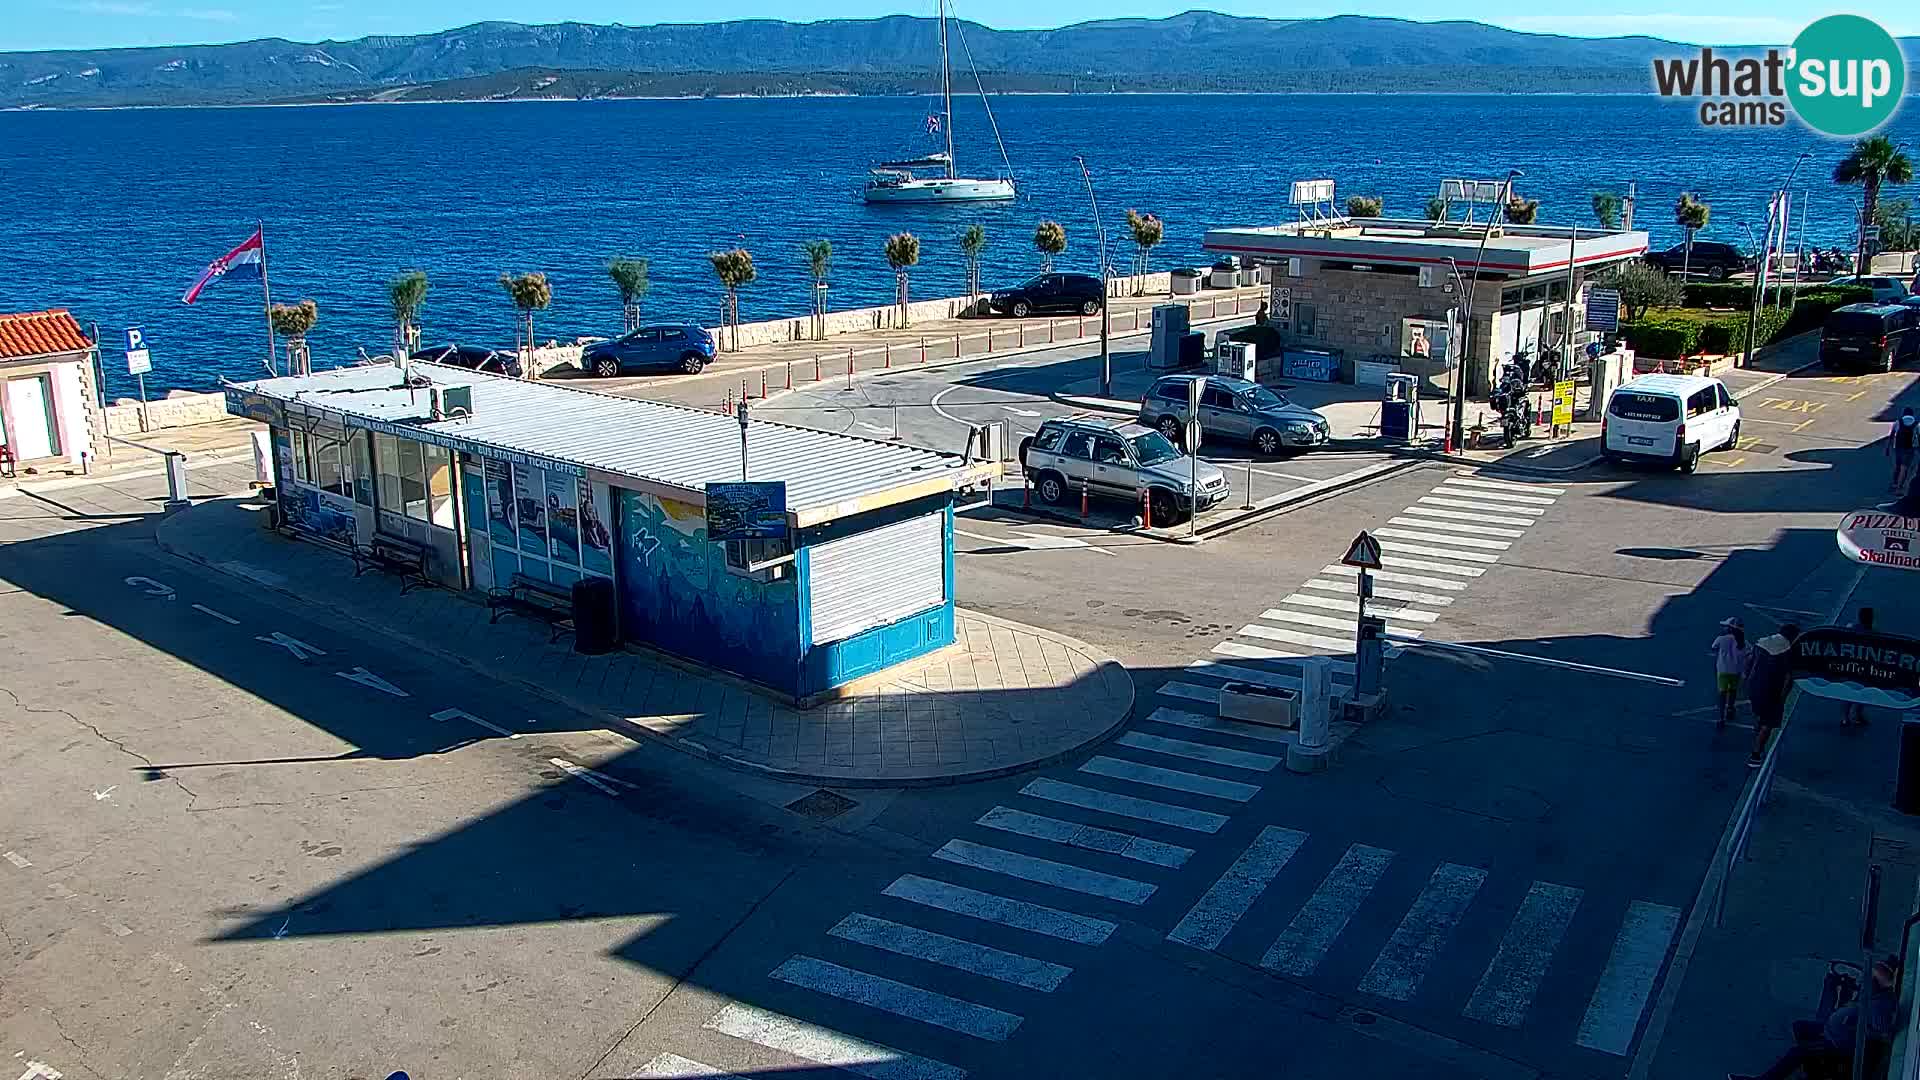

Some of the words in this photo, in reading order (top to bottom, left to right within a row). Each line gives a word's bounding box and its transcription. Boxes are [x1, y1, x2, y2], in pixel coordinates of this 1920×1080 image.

[129, 330, 142, 349] P
[1636, 395, 1656, 403] TAXI
[1758, 397, 1829, 413] TAXI
[478, 445, 493, 457] BUS
[493, 449, 526, 465] STATION
[527, 455, 554, 471] TICKET
[554, 463, 582, 477] OFFICE
[1848, 515, 1920, 532] PIZZE
[1869, 663, 1896, 680] bar
